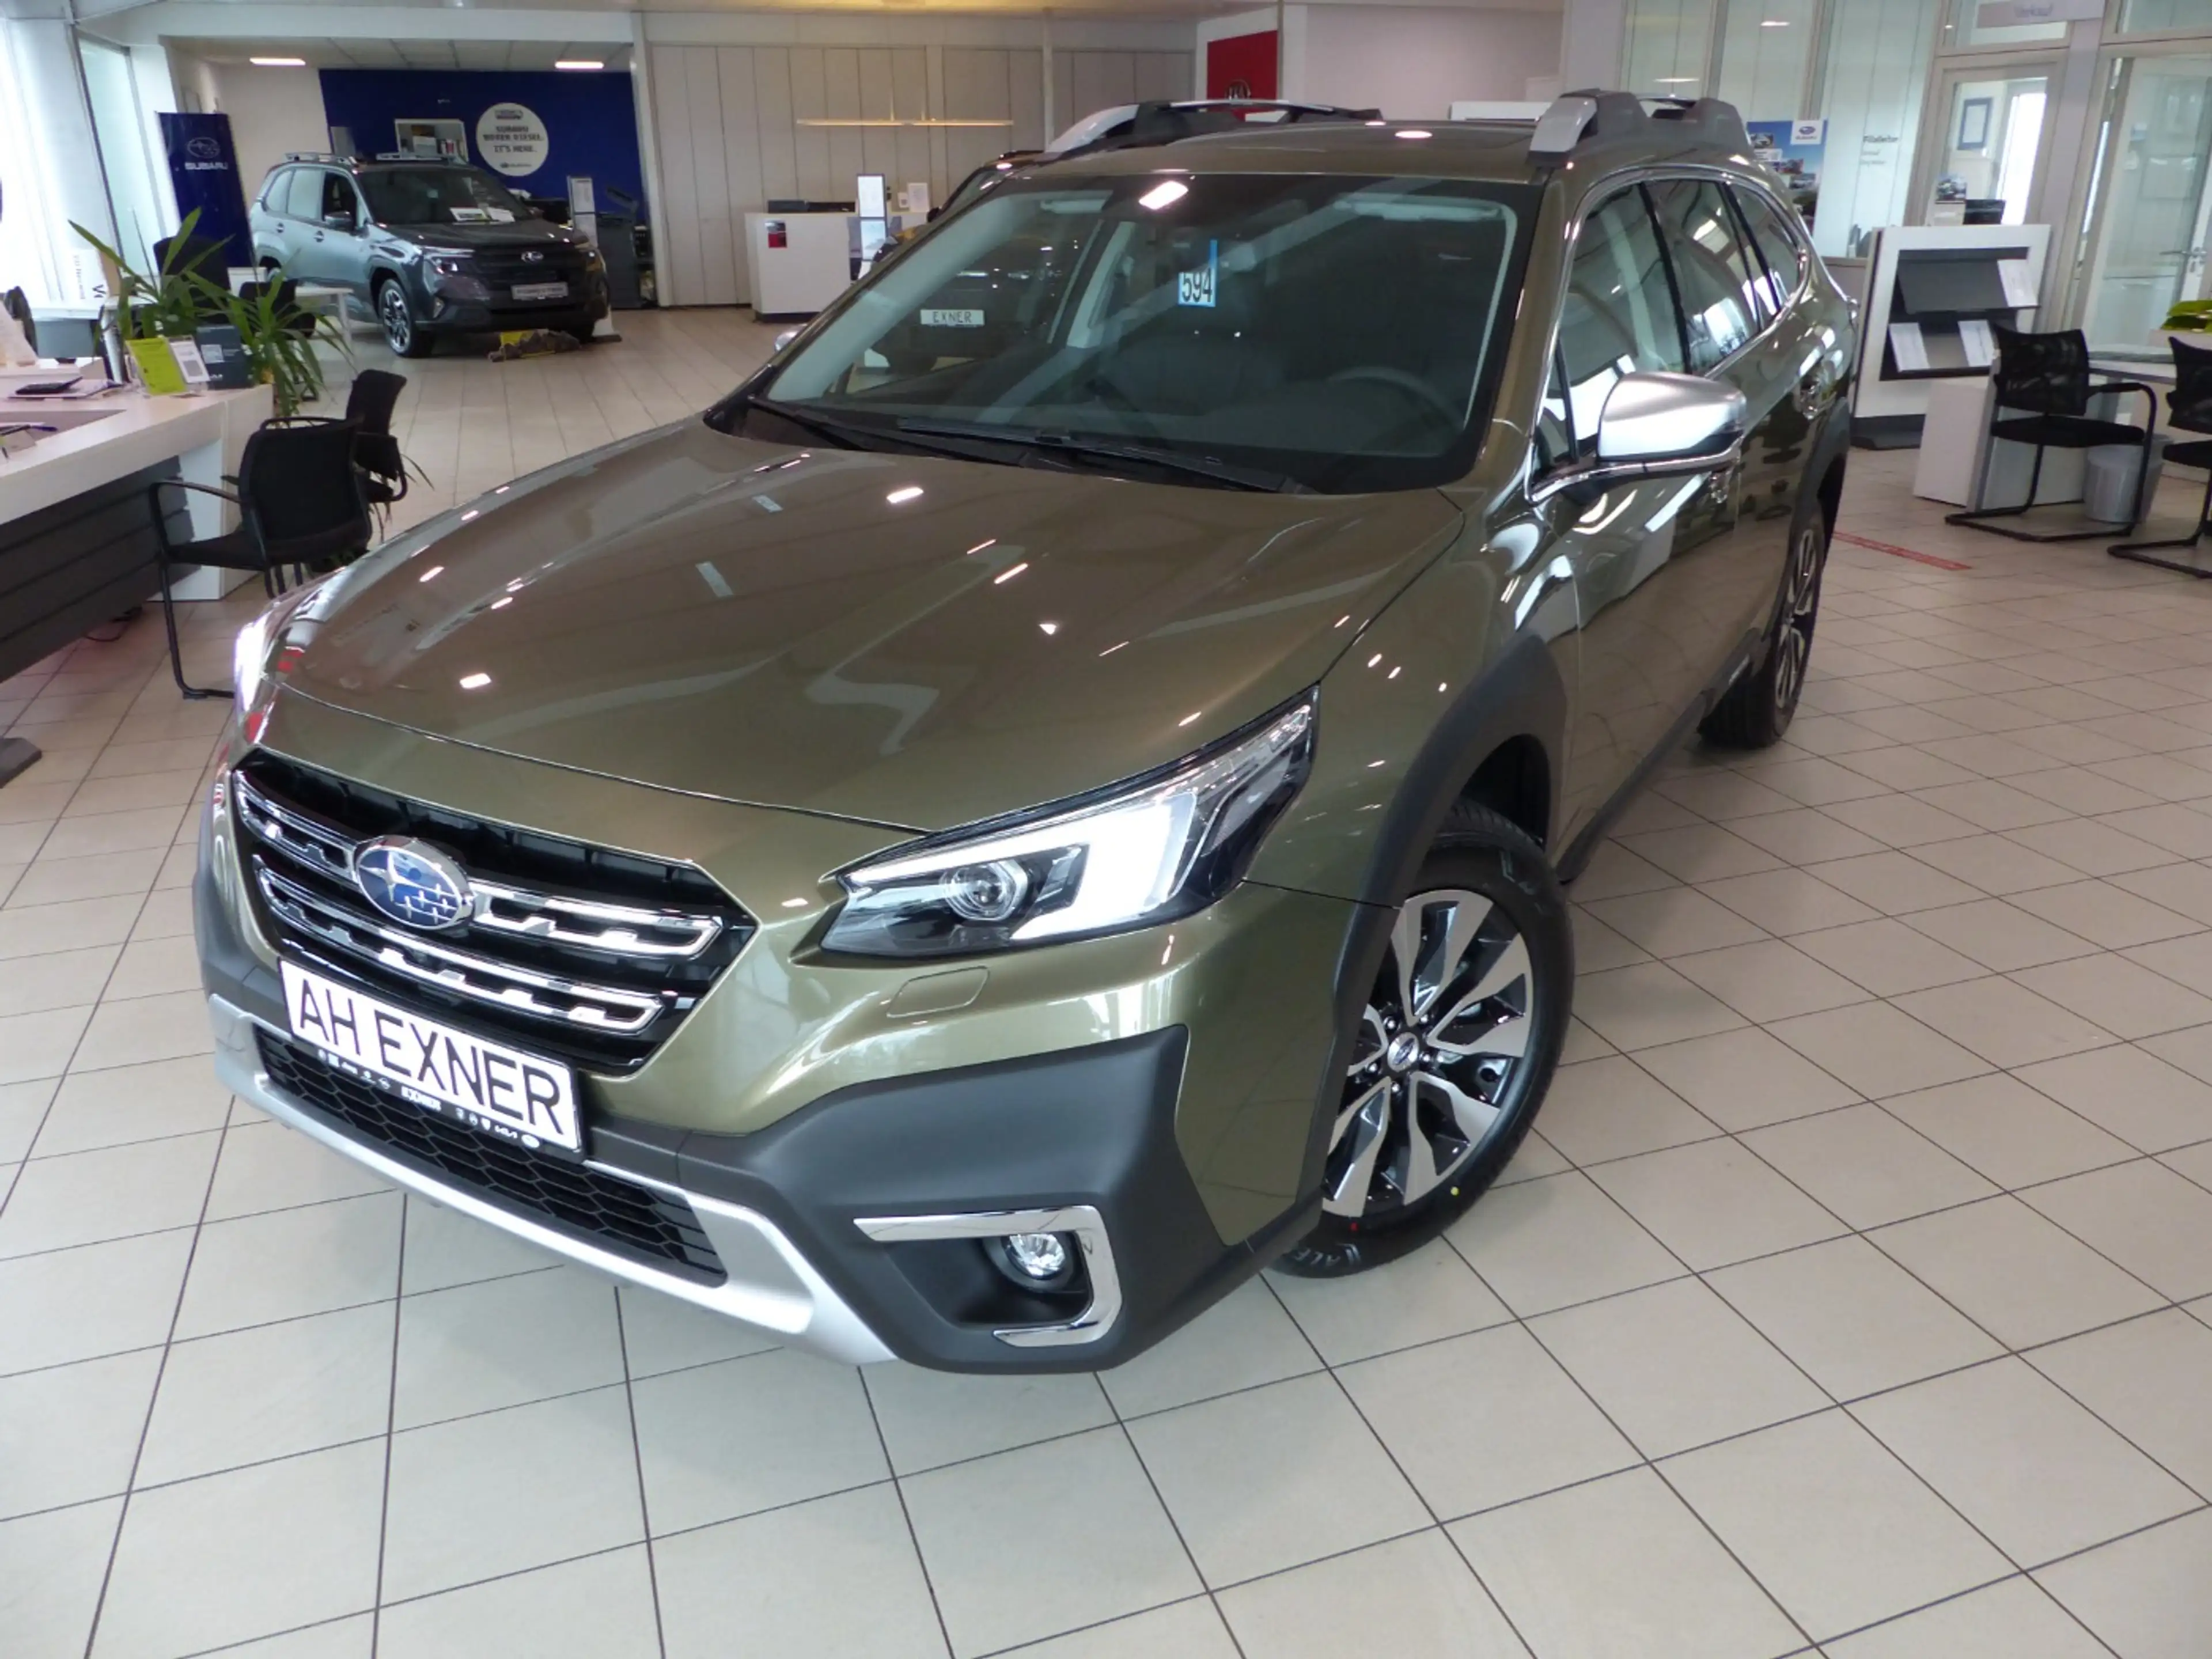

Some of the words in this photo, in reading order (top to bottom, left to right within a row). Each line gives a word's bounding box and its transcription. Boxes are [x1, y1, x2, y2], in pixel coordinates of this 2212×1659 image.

[185, 162, 229, 170] SUBARU
[1182, 268, 1213, 302] 594
[933, 311, 972, 323] EXNER
[300, 978, 361, 1056] AH
[374, 1009, 565, 1135] EXNER
